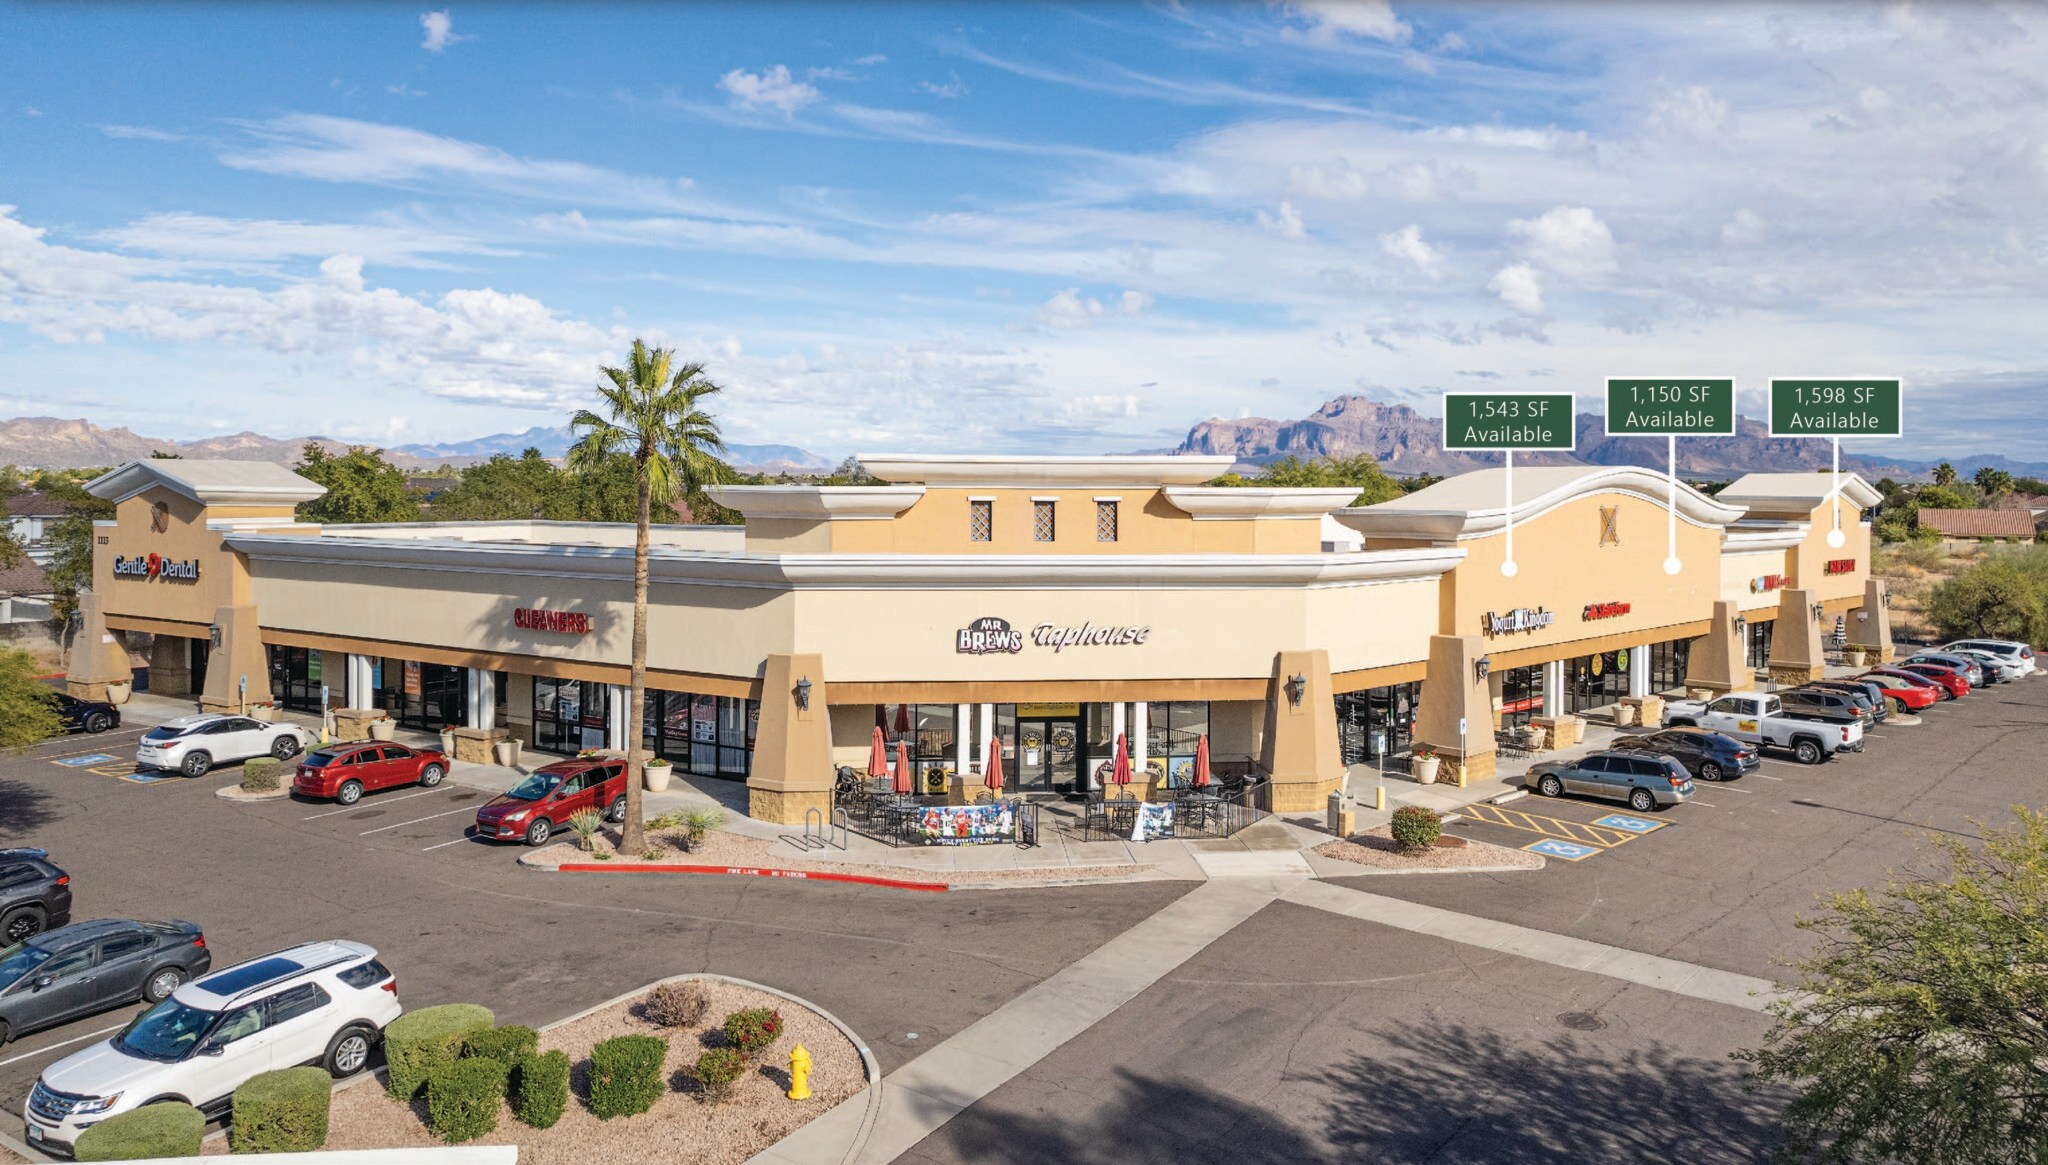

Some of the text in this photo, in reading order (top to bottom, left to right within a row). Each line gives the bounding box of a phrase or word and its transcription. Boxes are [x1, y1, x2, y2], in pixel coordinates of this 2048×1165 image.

[97, 536, 109, 545] 1113
[113, 554, 199, 579] Gentle Dental
[513, 607, 590, 634] CLEANERS
[979, 618, 1003, 631] MR
[1489, 607, 1555, 635] Yogurt Kingdom
[957, 620, 1151, 654] BREWS Taphouse
